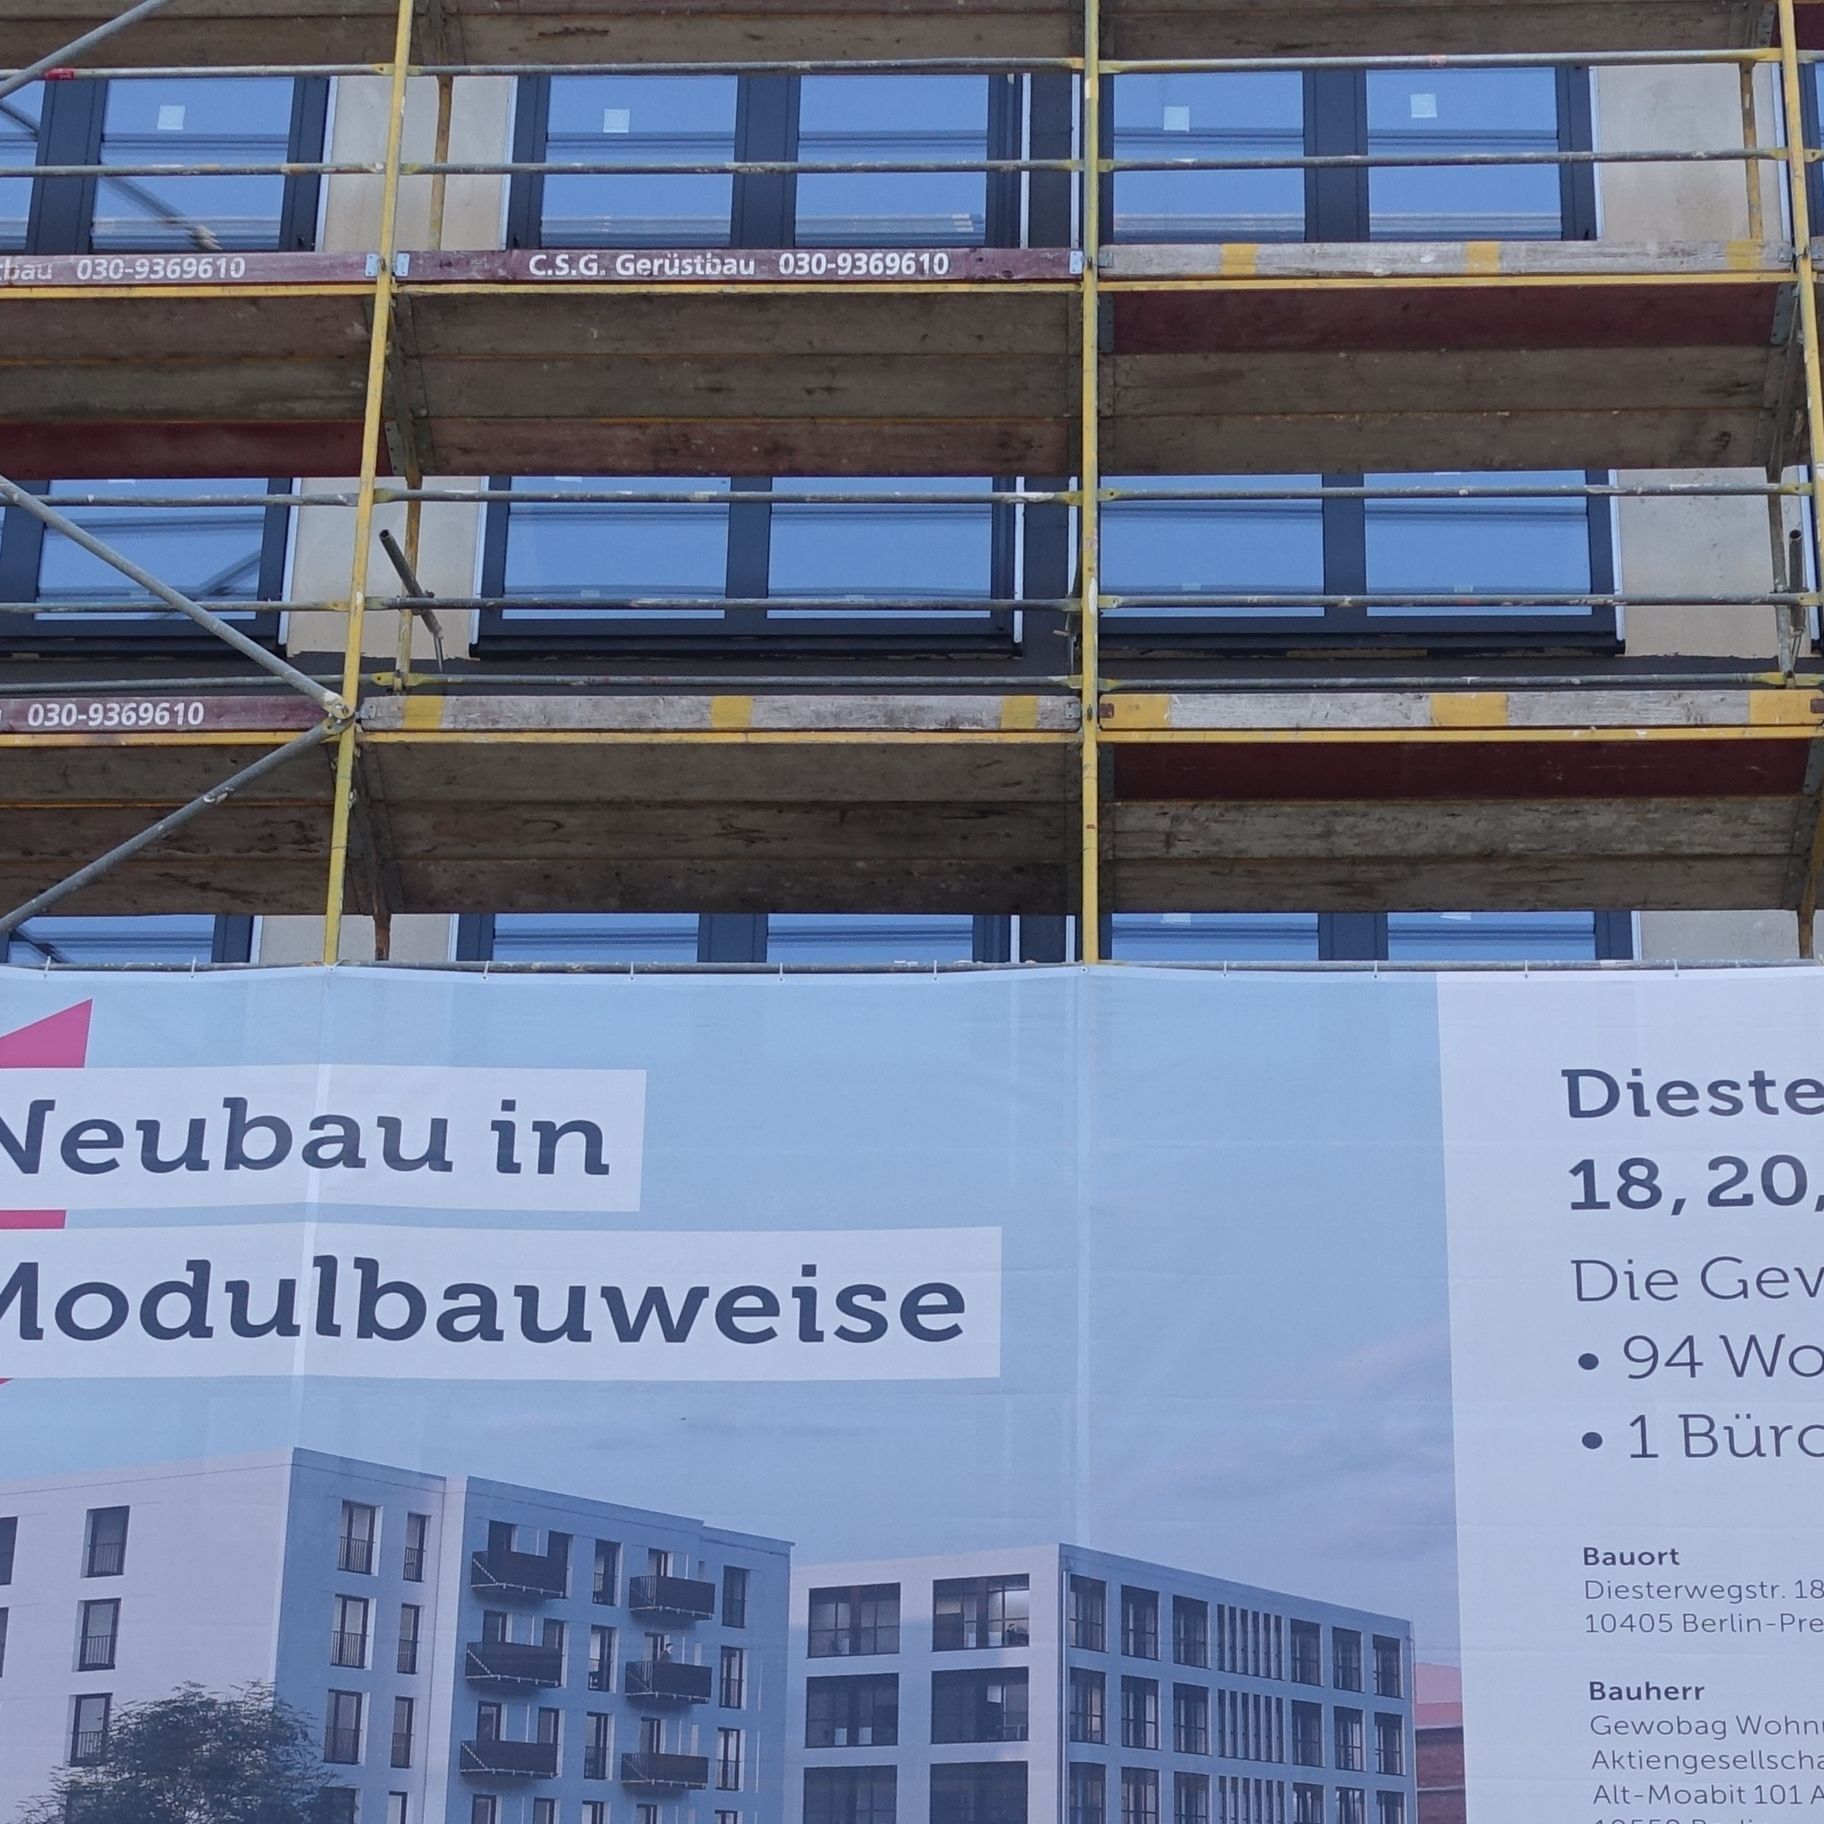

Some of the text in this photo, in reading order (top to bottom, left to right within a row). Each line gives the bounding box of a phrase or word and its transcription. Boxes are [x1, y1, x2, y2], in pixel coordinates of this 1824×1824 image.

[76, 256, 246, 281] 030-9369610
[529, 252, 949, 277] C.S.G. Gerüstbau 030-9369610
[27, 702, 205, 727] 030-9369610
[490, 1098, 610, 1176] in
[1568, 1157, 1687, 1216] 18,
[1570, 1258, 1679, 1302] Die
[1623, 1334, 1704, 1380] 94
[1629, 1414, 1659, 1459] 1
[1583, 1546, 1680, 1567] Bauort
[1584, 1579, 1786, 1605] Diesterwegstr.
[1585, 1613, 1673, 1634] 10405
[1589, 1680, 1705, 1701] Bauherr
[1590, 1714, 1727, 1741] Gewobag
[1592, 1784, 1747, 1805] Alt-Moabit
[1754, 1784, 1803, 1805] 101
